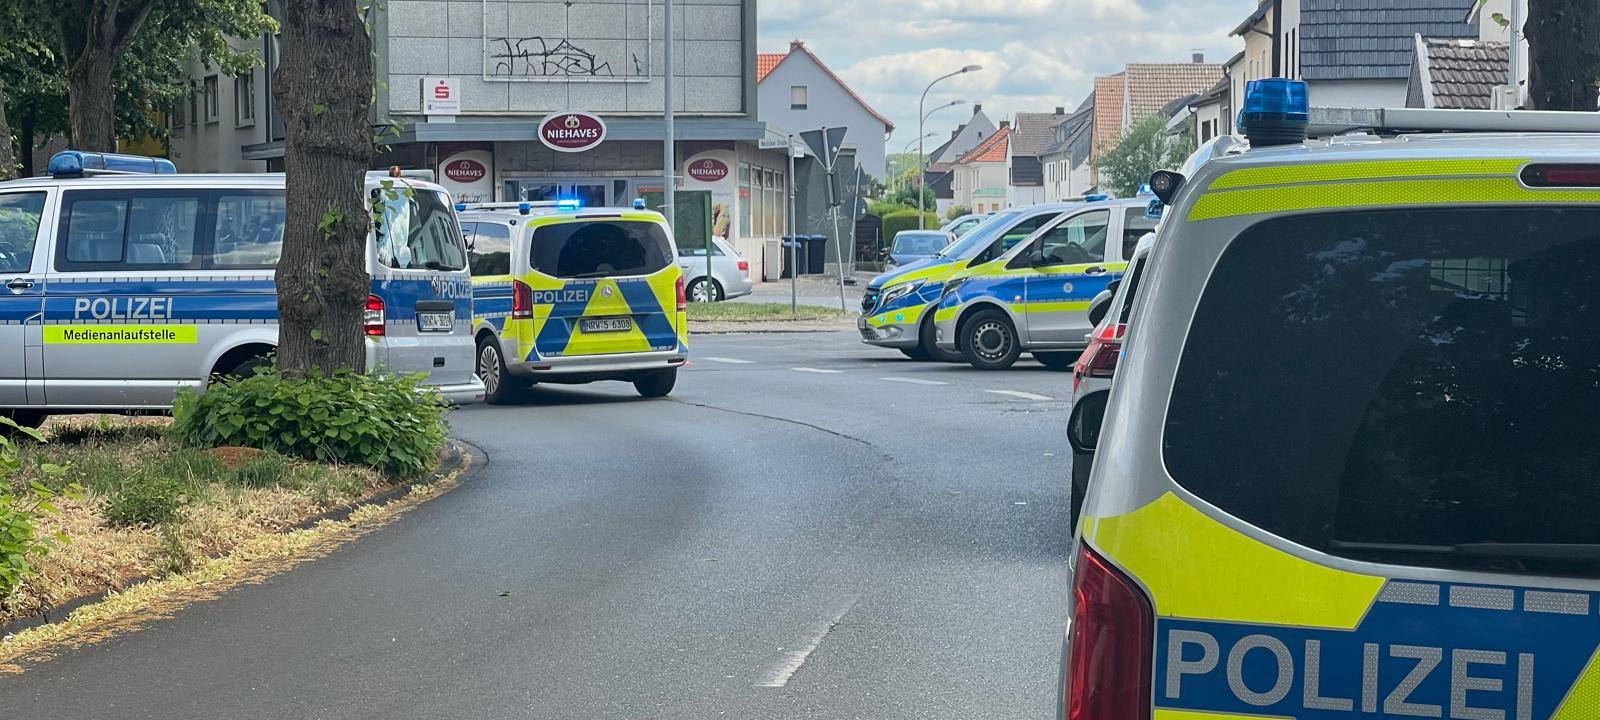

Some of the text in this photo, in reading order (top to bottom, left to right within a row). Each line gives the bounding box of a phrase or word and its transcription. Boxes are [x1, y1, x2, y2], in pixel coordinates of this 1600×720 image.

[547, 128, 598, 139] NIEHAVES
[448, 169, 482, 177] NIEHAVES
[691, 168, 725, 176] NIEHAVES
[441, 281, 470, 299] POLIZE
[534, 289, 589, 304] POLIZEI
[74, 297, 173, 320] POLIZEI
[586, 320, 600, 330] NRW
[63, 329, 176, 340] Medienanlaufstelle
[1165, 629, 1535, 720] POLIZEI
